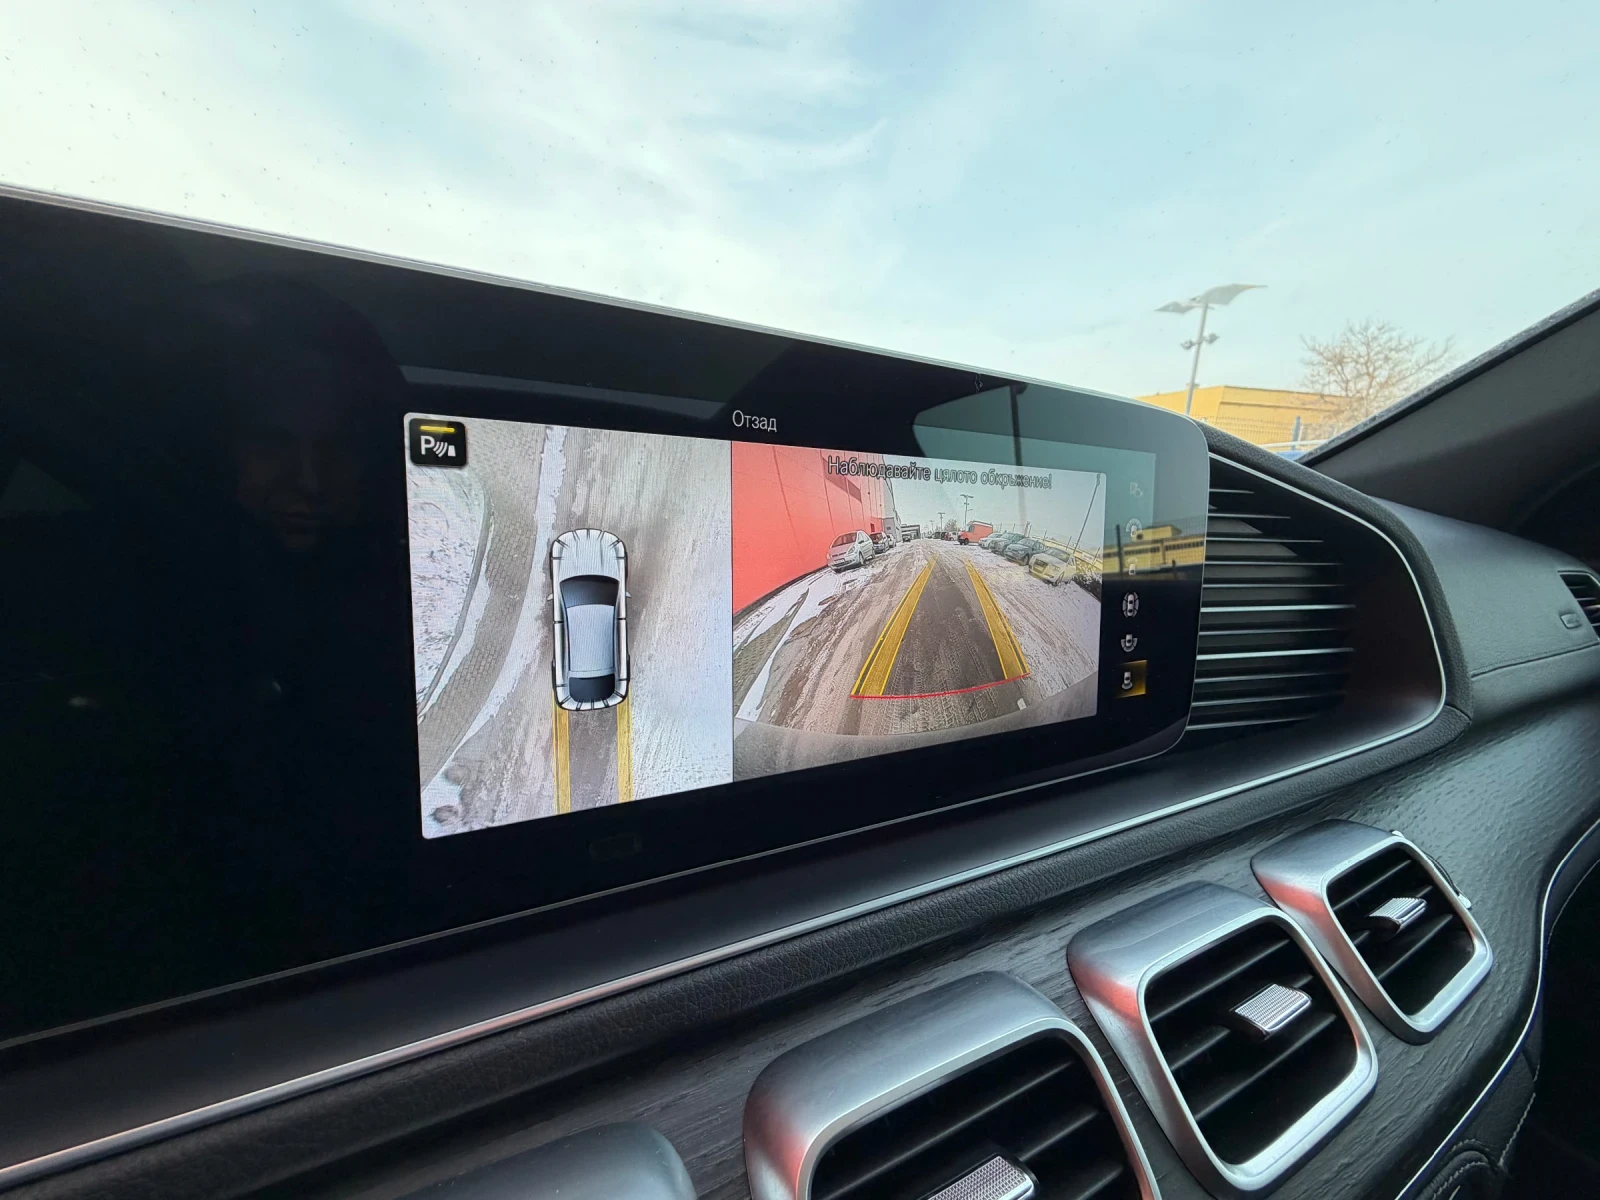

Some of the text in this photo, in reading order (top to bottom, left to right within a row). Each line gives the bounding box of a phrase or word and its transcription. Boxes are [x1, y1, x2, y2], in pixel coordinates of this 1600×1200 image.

[732, 409, 778, 433] Отзад
[420, 435, 435, 455] P
[828, 455, 1052, 490] Наблюдавайте цялото обкръжение!
